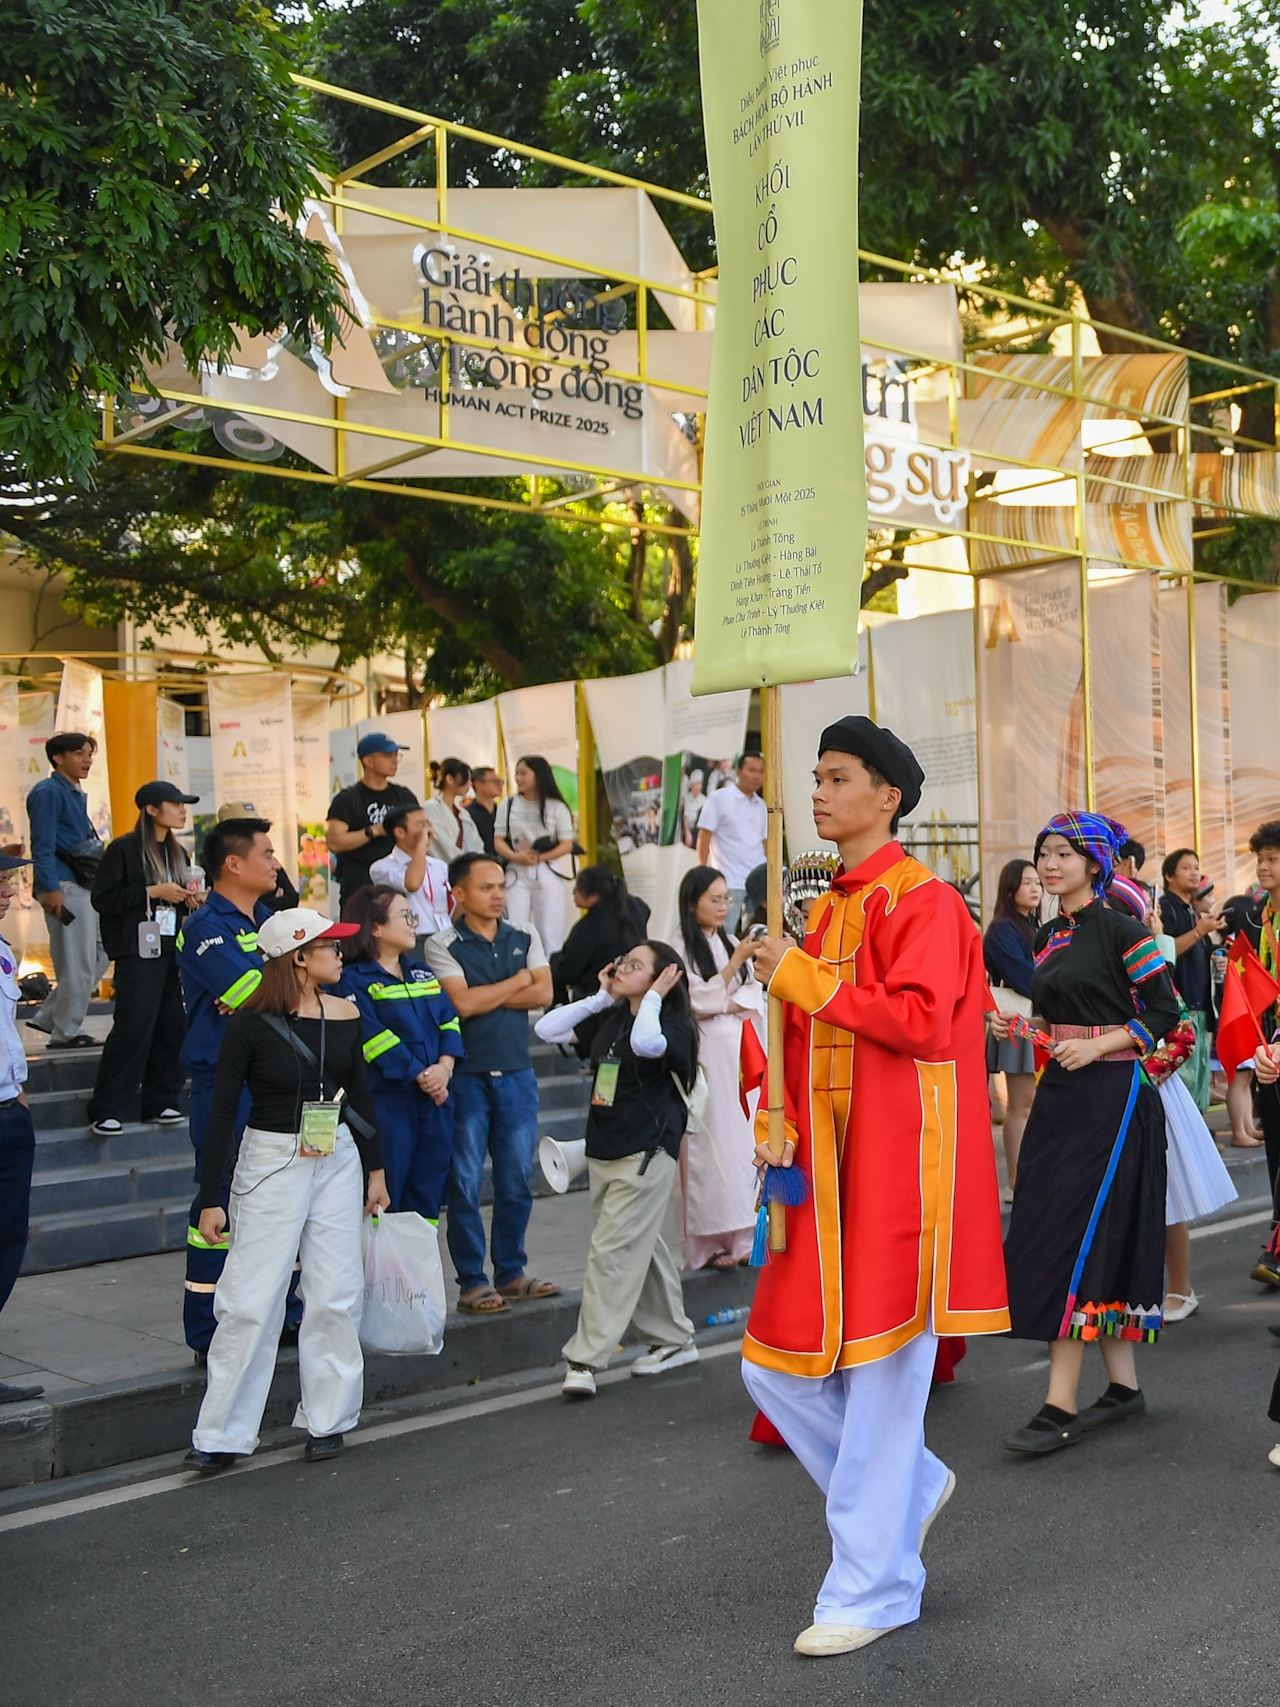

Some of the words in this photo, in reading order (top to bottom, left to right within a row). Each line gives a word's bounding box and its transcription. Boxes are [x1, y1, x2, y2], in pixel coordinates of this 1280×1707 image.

[768, 64, 787, 82] Việt
[791, 55, 818, 78] phục
[770, 85, 788, 109] BỘ
[793, 72, 832, 100] HÀNH
[762, 113, 783, 142] THỨ
[785, 110, 804, 128] VII
[755, 158, 790, 208] KHỐI
[757, 203, 778, 251] CỔ
[420, 248, 492, 297] Giải
[753, 257, 798, 303] PHỤC
[422, 287, 514, 343] hành
[754, 307, 785, 347] CÁC
[465, 345, 553, 401] cộng
[561, 364, 645, 420] đồng
[742, 363, 765, 403] DÂN
[768, 347, 820, 387] TỘC
[425, 387, 490, 412] HUMAN
[495, 402, 526, 418] ACT
[530, 407, 572, 428] PRIZE
[575, 417, 609, 435] 2025
[739, 411, 763, 449] VIỆT
[767, 397, 824, 434] NAM
[775, 492, 792, 504] Một
[794, 487, 816, 501] 2025
[907, 452, 966, 515] sự
[773, 533, 795, 545] Tông
[779, 550, 803, 562] Hàng
[779, 568, 791, 579] Lê
[793, 565, 811, 578] Thái
[722, 615, 734, 626] Phan
[767, 605, 778, 619] Lý
[809, 599, 826, 612] Kiệt
[750, 592, 764, 604] Khay
[768, 587, 793, 600] Tràng
[748, 624, 772, 637] Thánh
[775, 622, 791, 635] Tông
